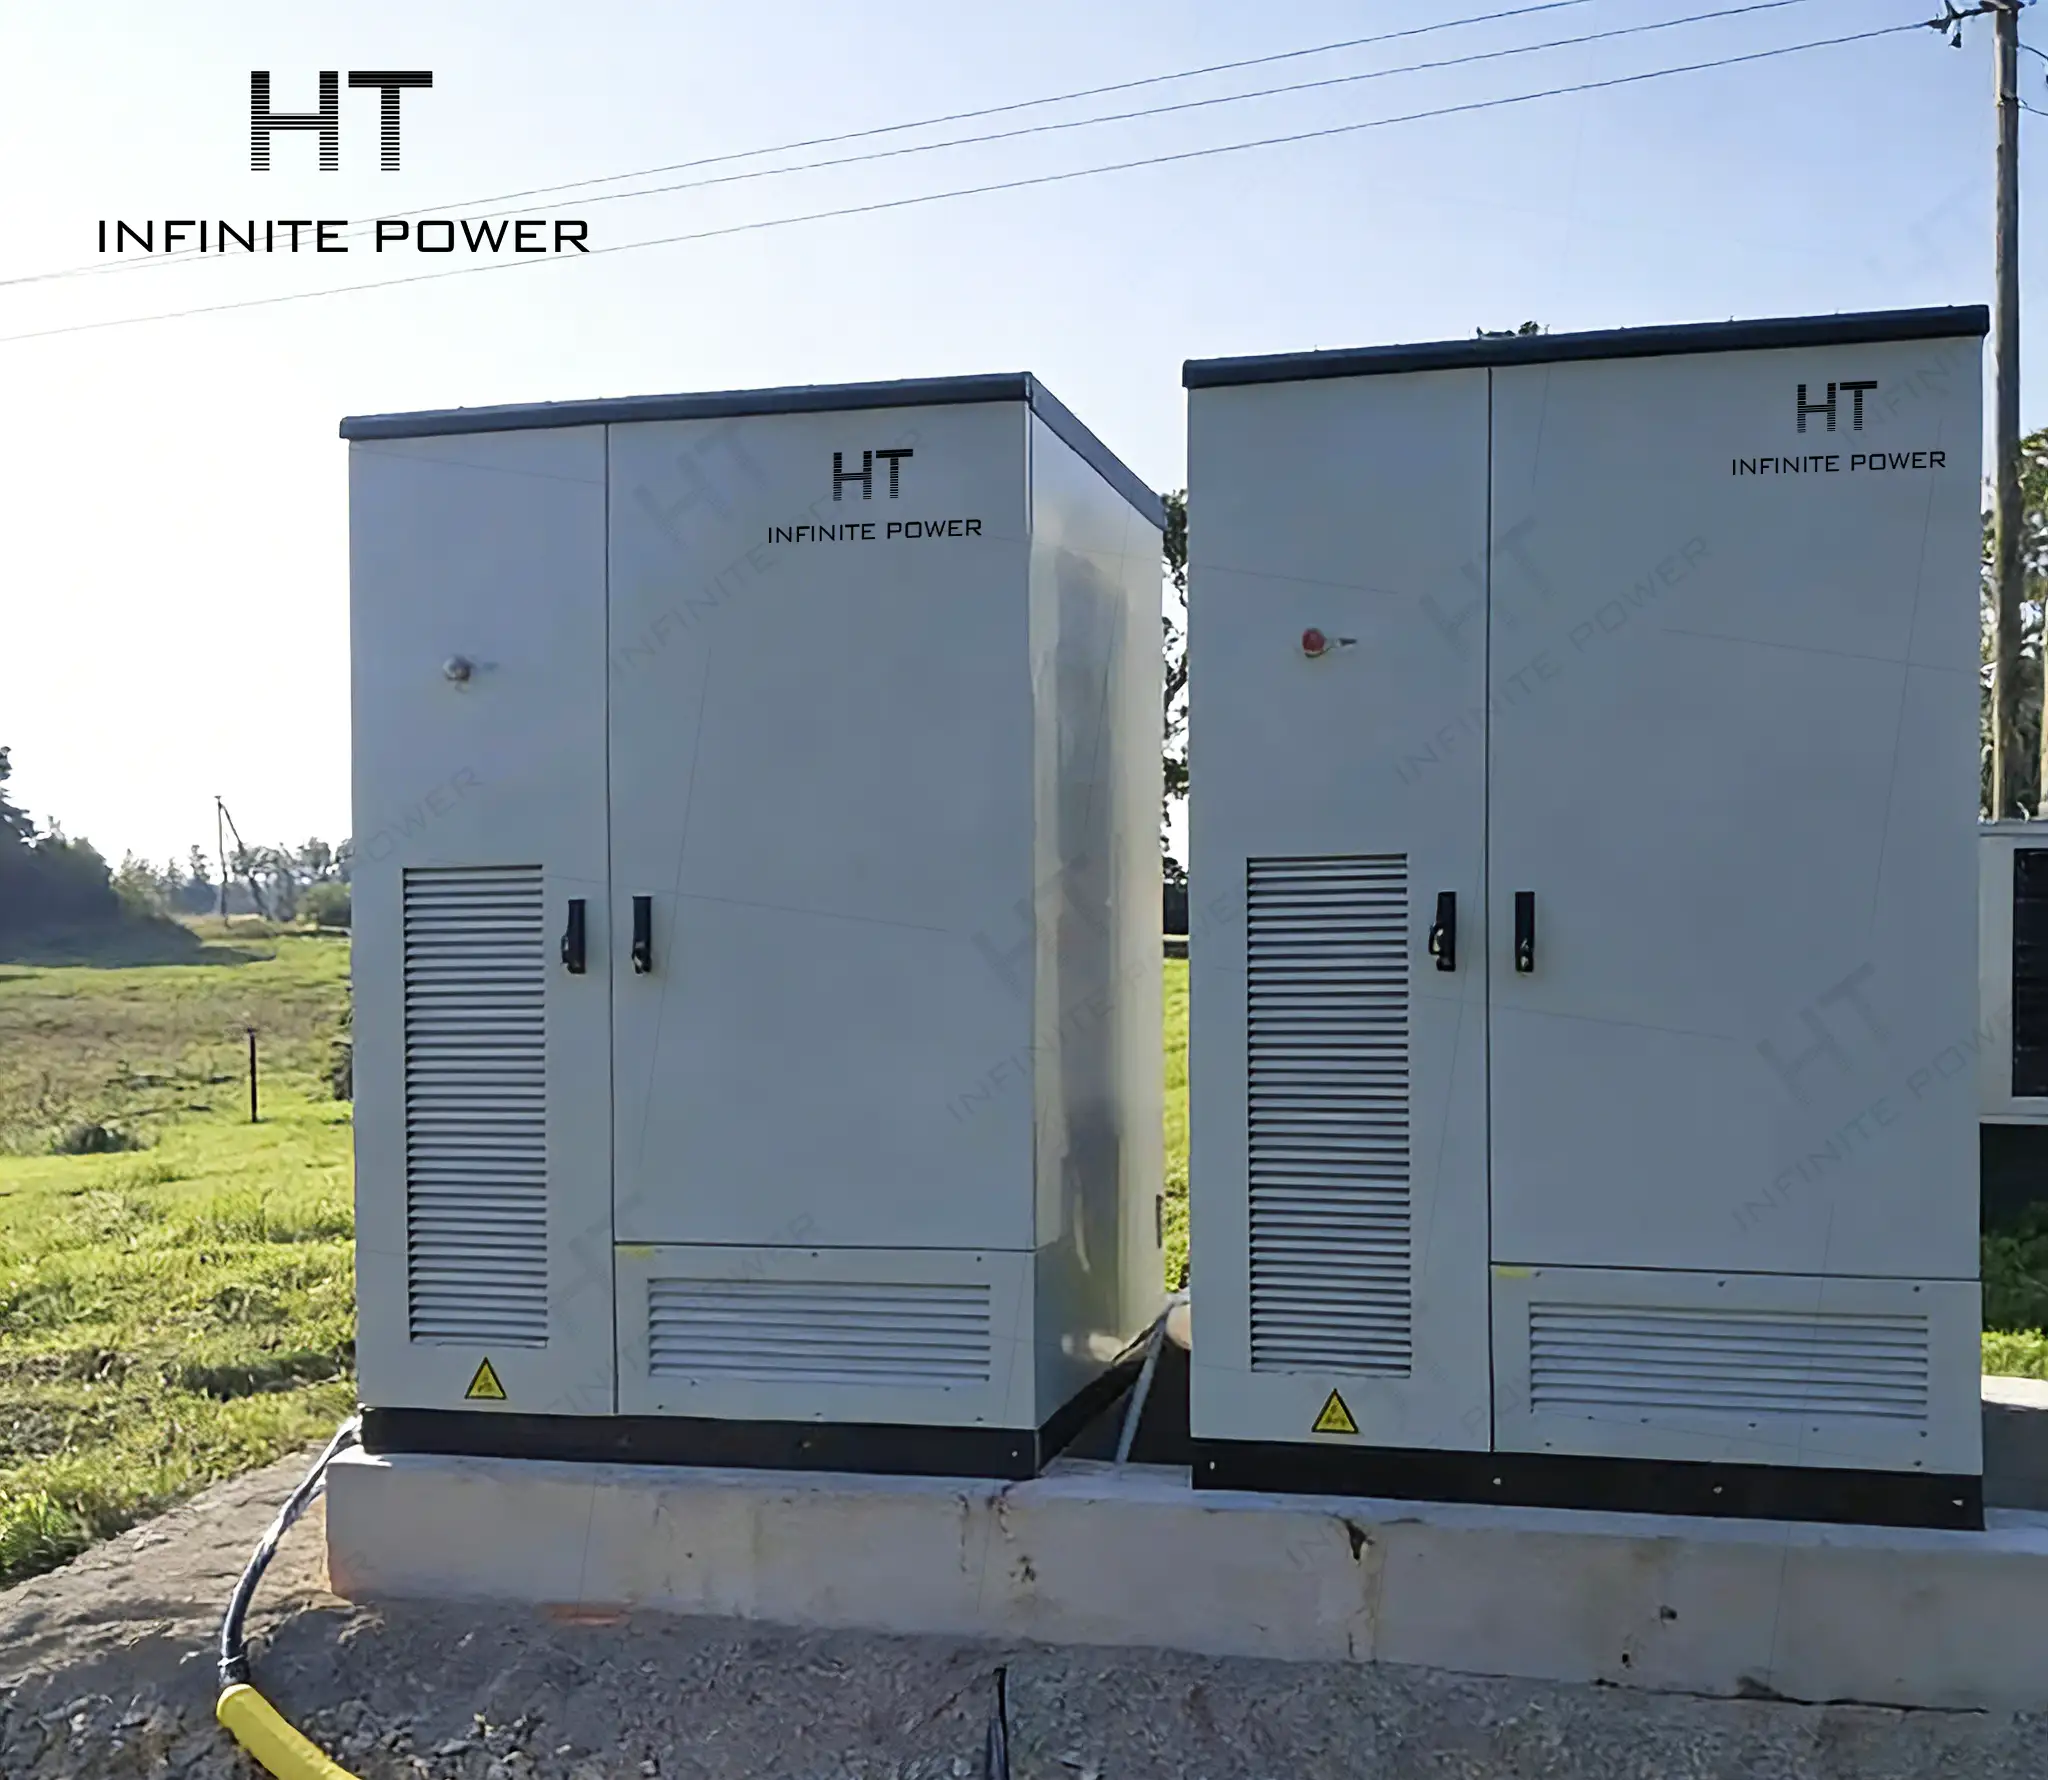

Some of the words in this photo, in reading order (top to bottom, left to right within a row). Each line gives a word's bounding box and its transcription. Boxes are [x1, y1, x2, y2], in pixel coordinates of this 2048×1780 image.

[1797, 380, 1879, 434] HT
[833, 448, 914, 502] HT
[1733, 453, 1841, 476] INFINITE
[1851, 450, 1947, 474] POWER
[768, 522, 877, 544] INFINITE
[886, 518, 983, 540] POWER
